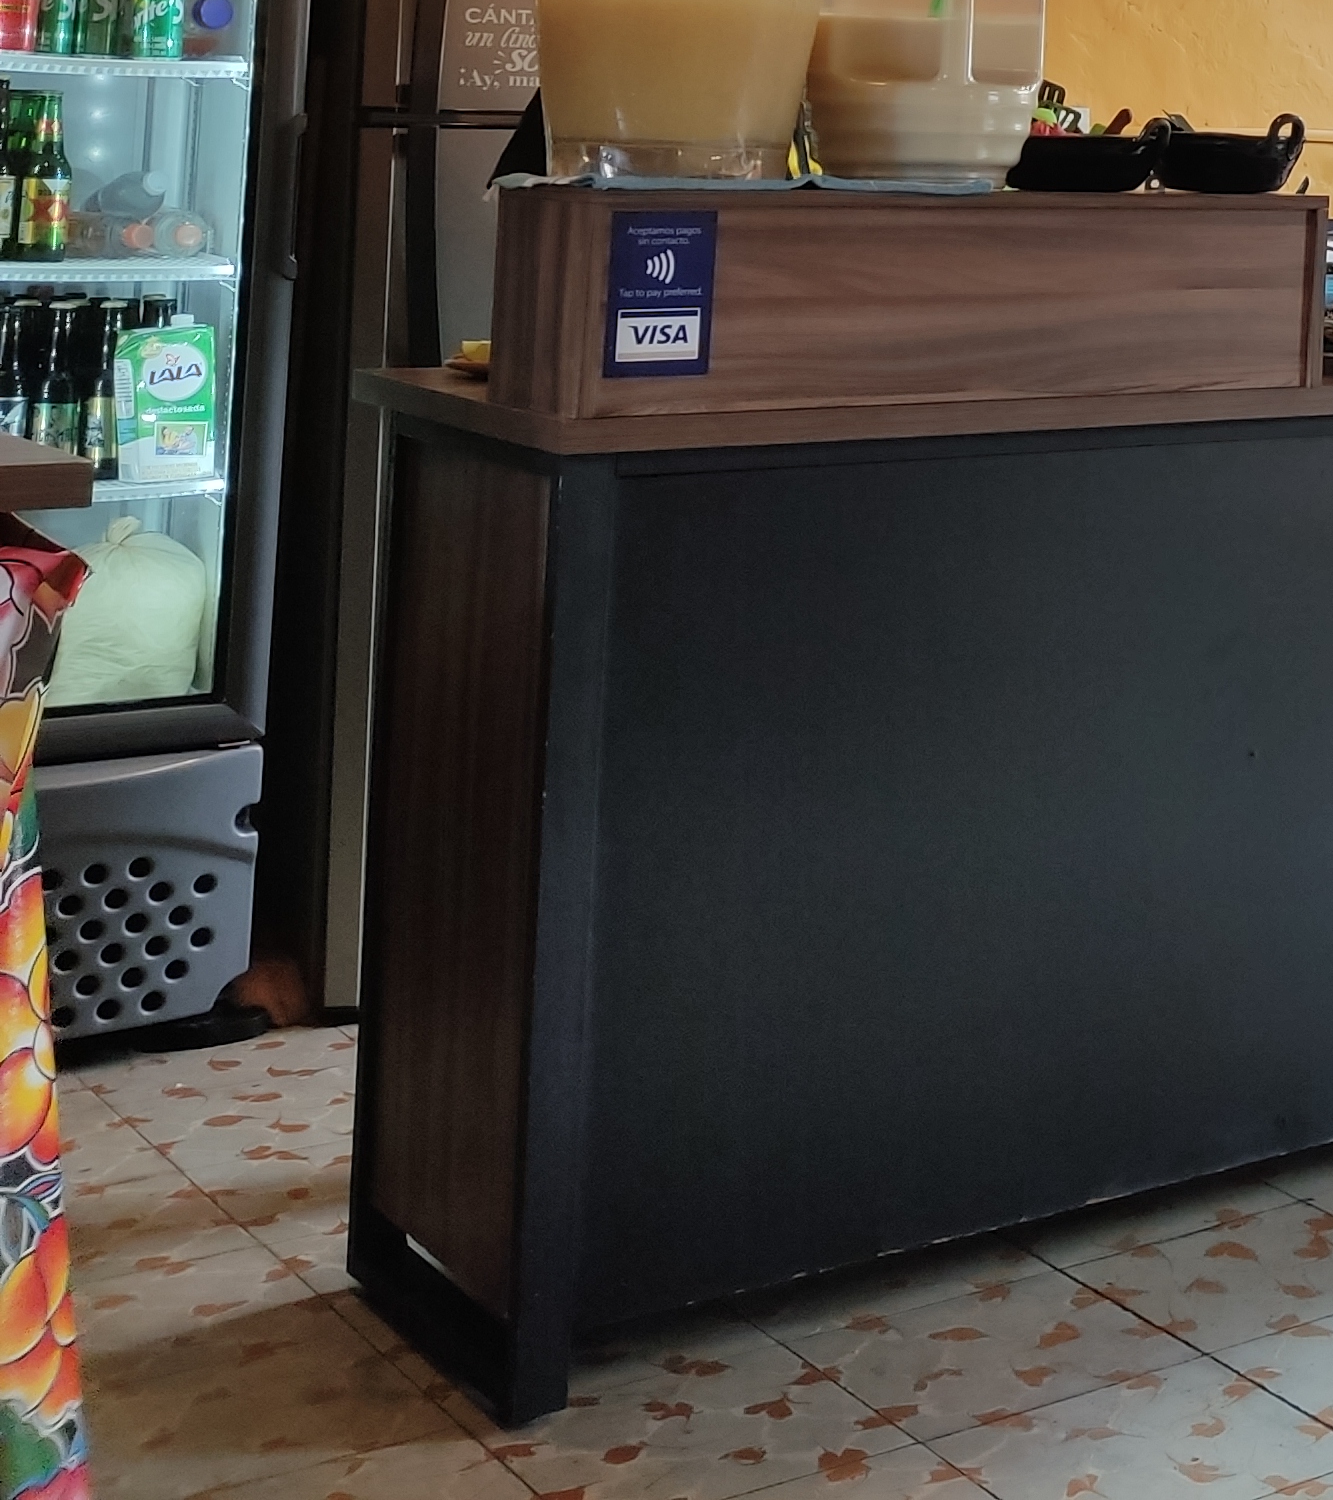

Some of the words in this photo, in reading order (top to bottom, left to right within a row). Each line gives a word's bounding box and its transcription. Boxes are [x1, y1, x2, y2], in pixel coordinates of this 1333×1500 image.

[465, 3, 535, 25] CÁNT
[465, 31, 494, 47] un
[637, 238, 650, 246] sin
[619, 288, 634, 298] Tap
[635, 288, 645, 297] to
[646, 290, 662, 299] pay
[628, 324, 689, 345] VISA
[149, 363, 203, 386] LALA
